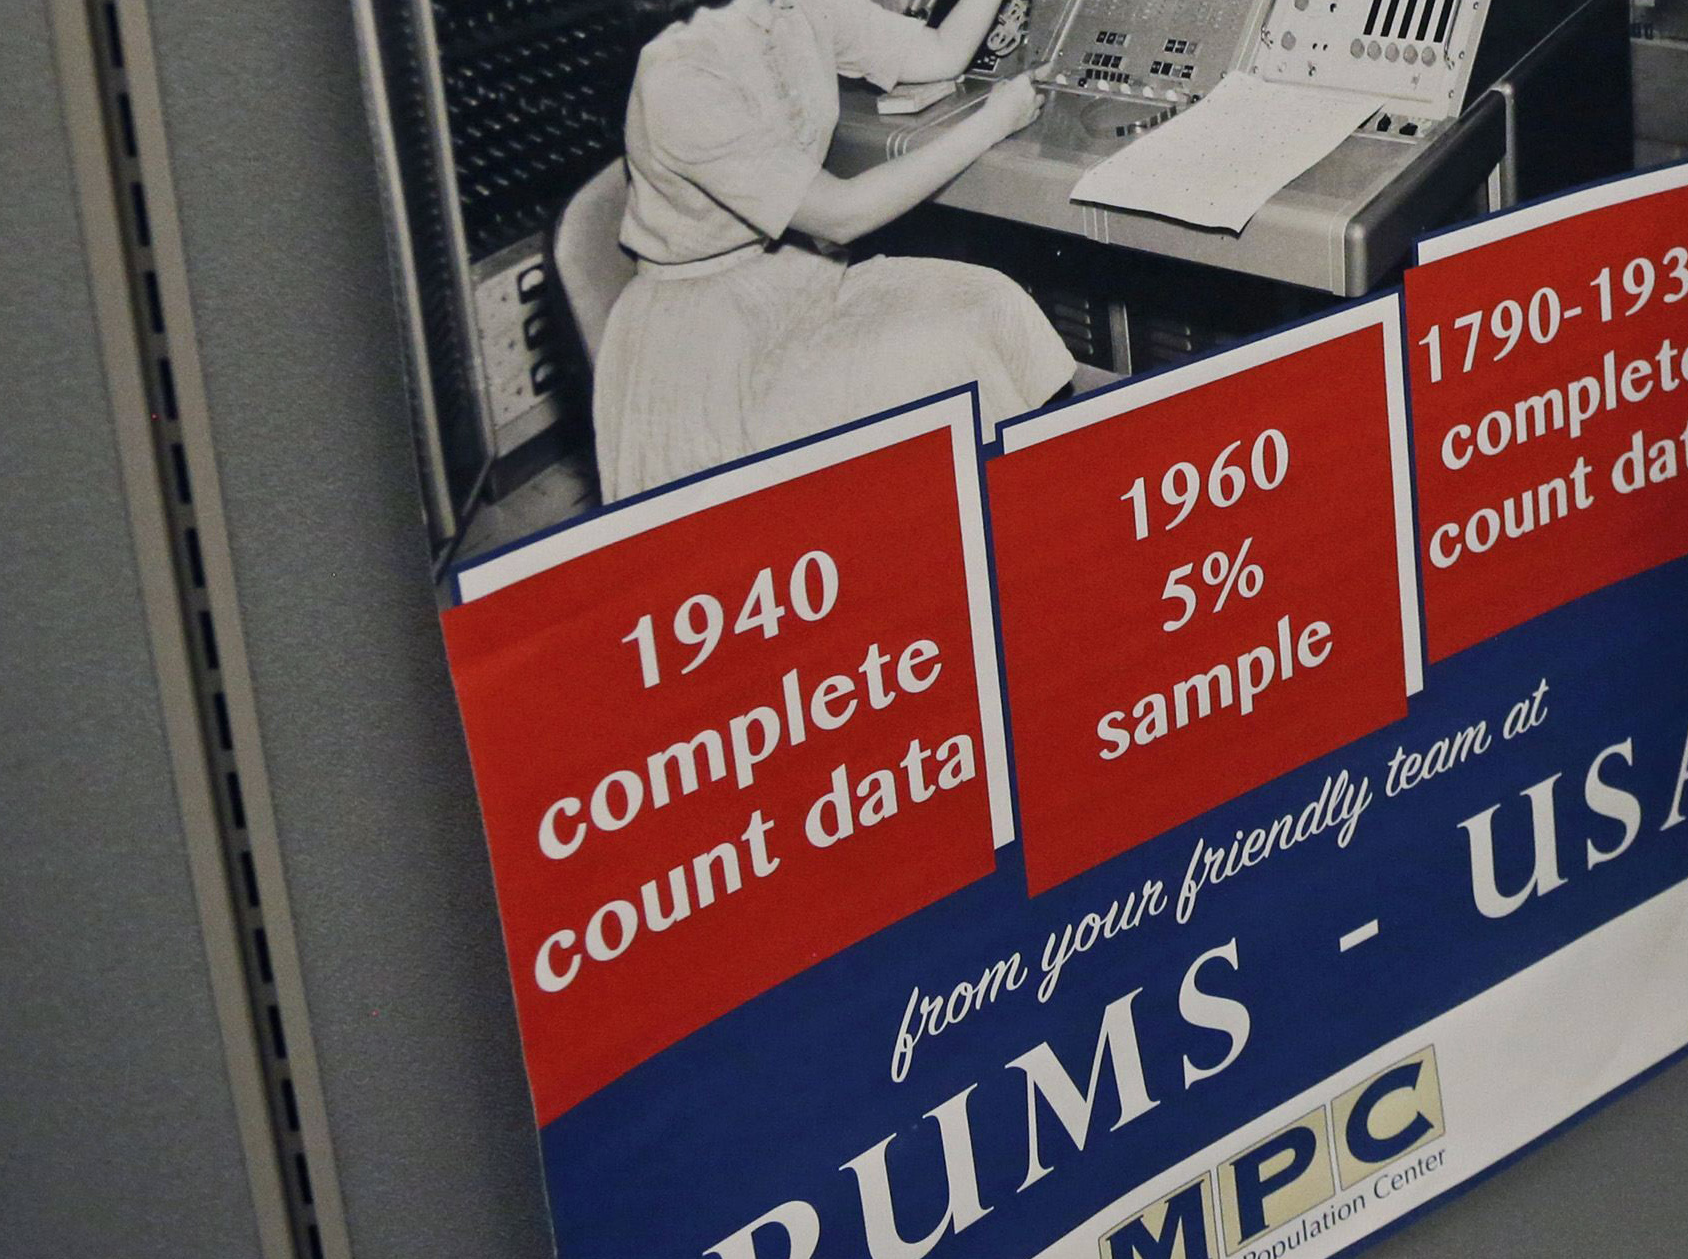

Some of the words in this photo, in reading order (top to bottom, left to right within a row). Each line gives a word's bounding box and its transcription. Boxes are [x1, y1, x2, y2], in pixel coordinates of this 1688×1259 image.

[1120, 428, 1289, 541] 1960
[1429, 456, 1594, 569] count
[621, 550, 839, 689] 1940
[1161, 536, 1264, 632] 5%
[538, 639, 942, 860] complete
[1096, 620, 1333, 760] sample
[534, 809, 781, 993] count
[804, 734, 976, 848] data
[890, 952, 1028, 1083] from
[1037, 879, 1168, 1004] your
[1175, 769, 1373, 925] friendly
[1385, 720, 1492, 798] team
[1502, 678, 1549, 740] at
[1105, 1060, 1435, 1259] MPC
[1373, 1149, 1445, 1199] Center
